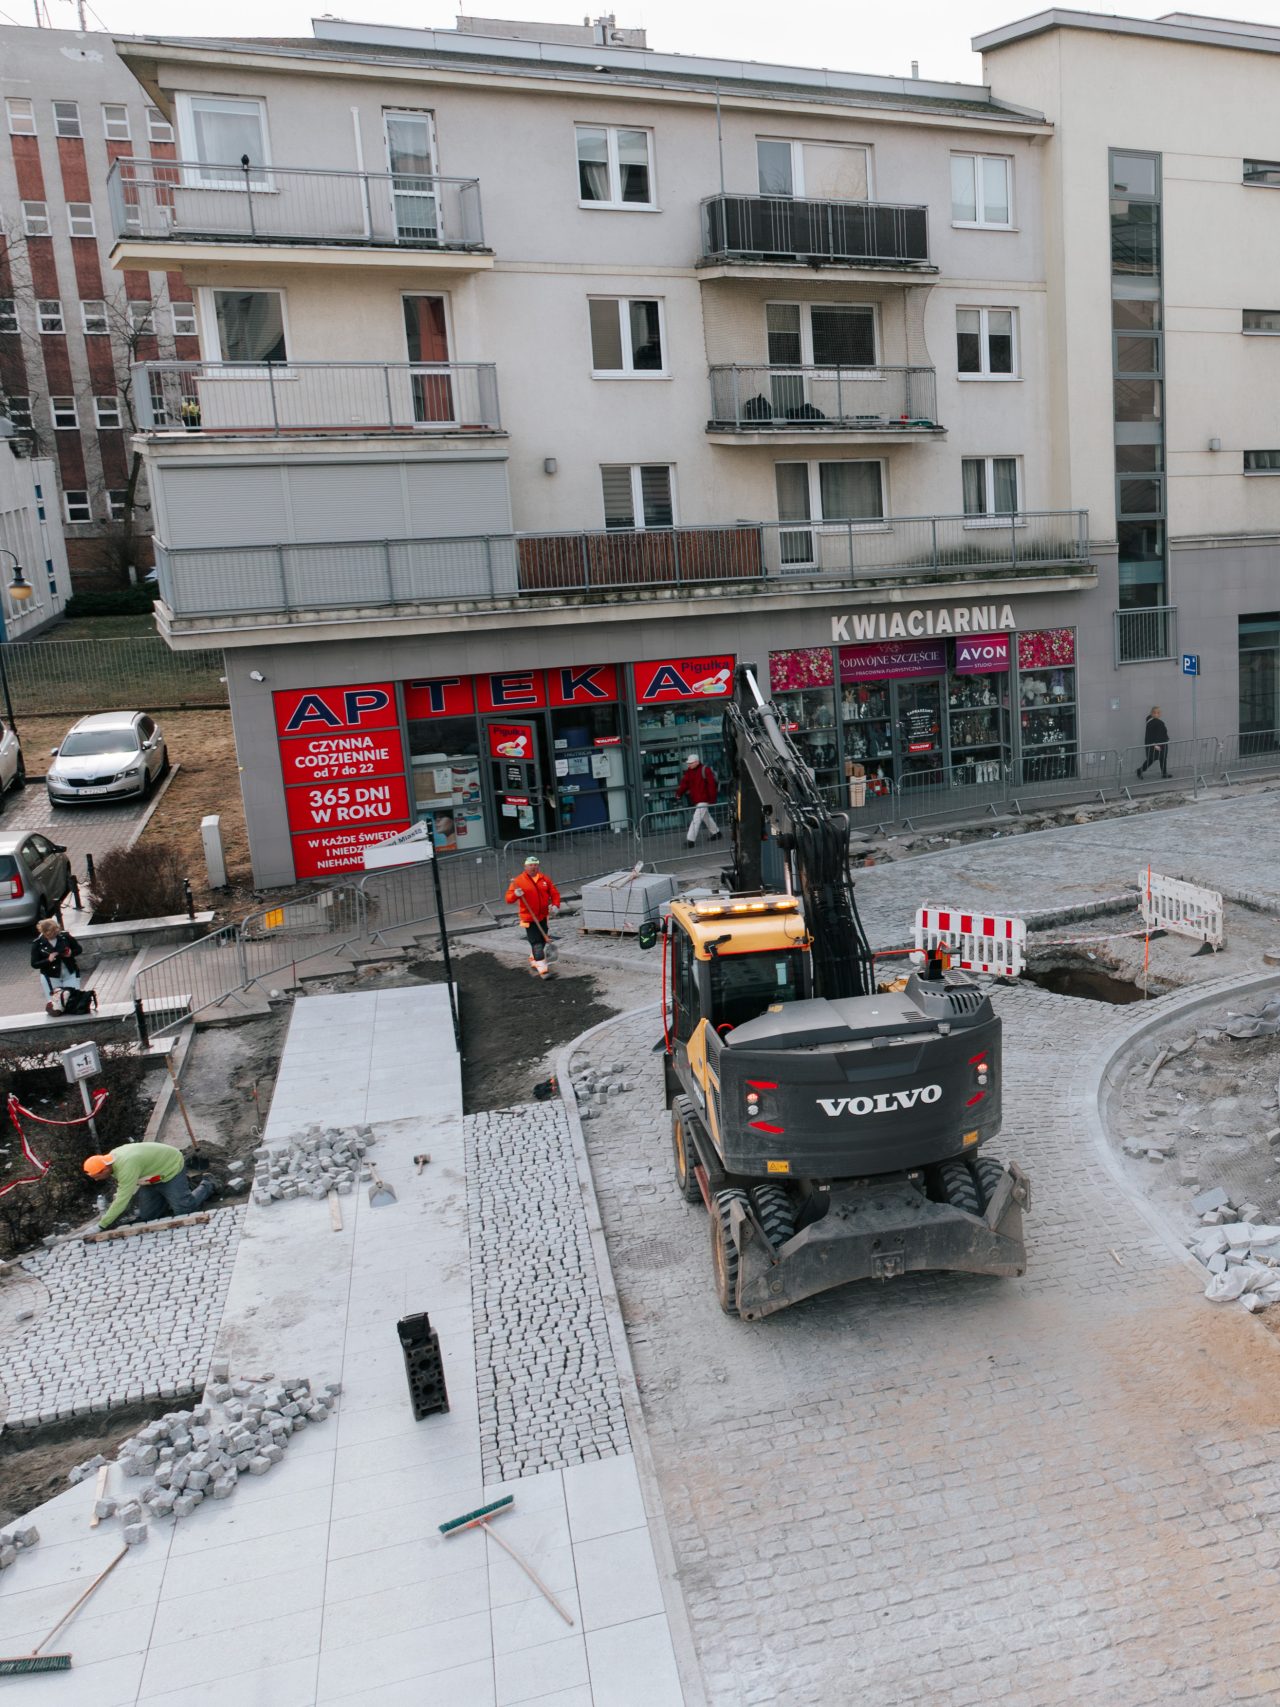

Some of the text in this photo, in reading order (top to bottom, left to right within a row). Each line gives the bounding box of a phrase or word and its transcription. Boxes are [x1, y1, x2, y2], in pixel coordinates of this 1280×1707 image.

[831, 604, 1016, 642] KWIACIARNIA
[891, 650, 940, 665] SZCZĘŚCIE
[959, 645, 1007, 661] AVON
[1184, 657, 1191, 671] P
[308, 736, 374, 753] CZYNNA
[295, 748, 390, 768] CODZIENNIE
[313, 763, 374, 778] od 7 do 22
[309, 785, 390, 807] 365 DNI
[310, 802, 391, 823] W ROKU
[308, 830, 398, 848] W KAŻDE ŚWIĘTO
[326, 848, 330, 857] I
[317, 855, 364, 869] NIEHAND
[816, 1084, 942, 1117] VOLVO
